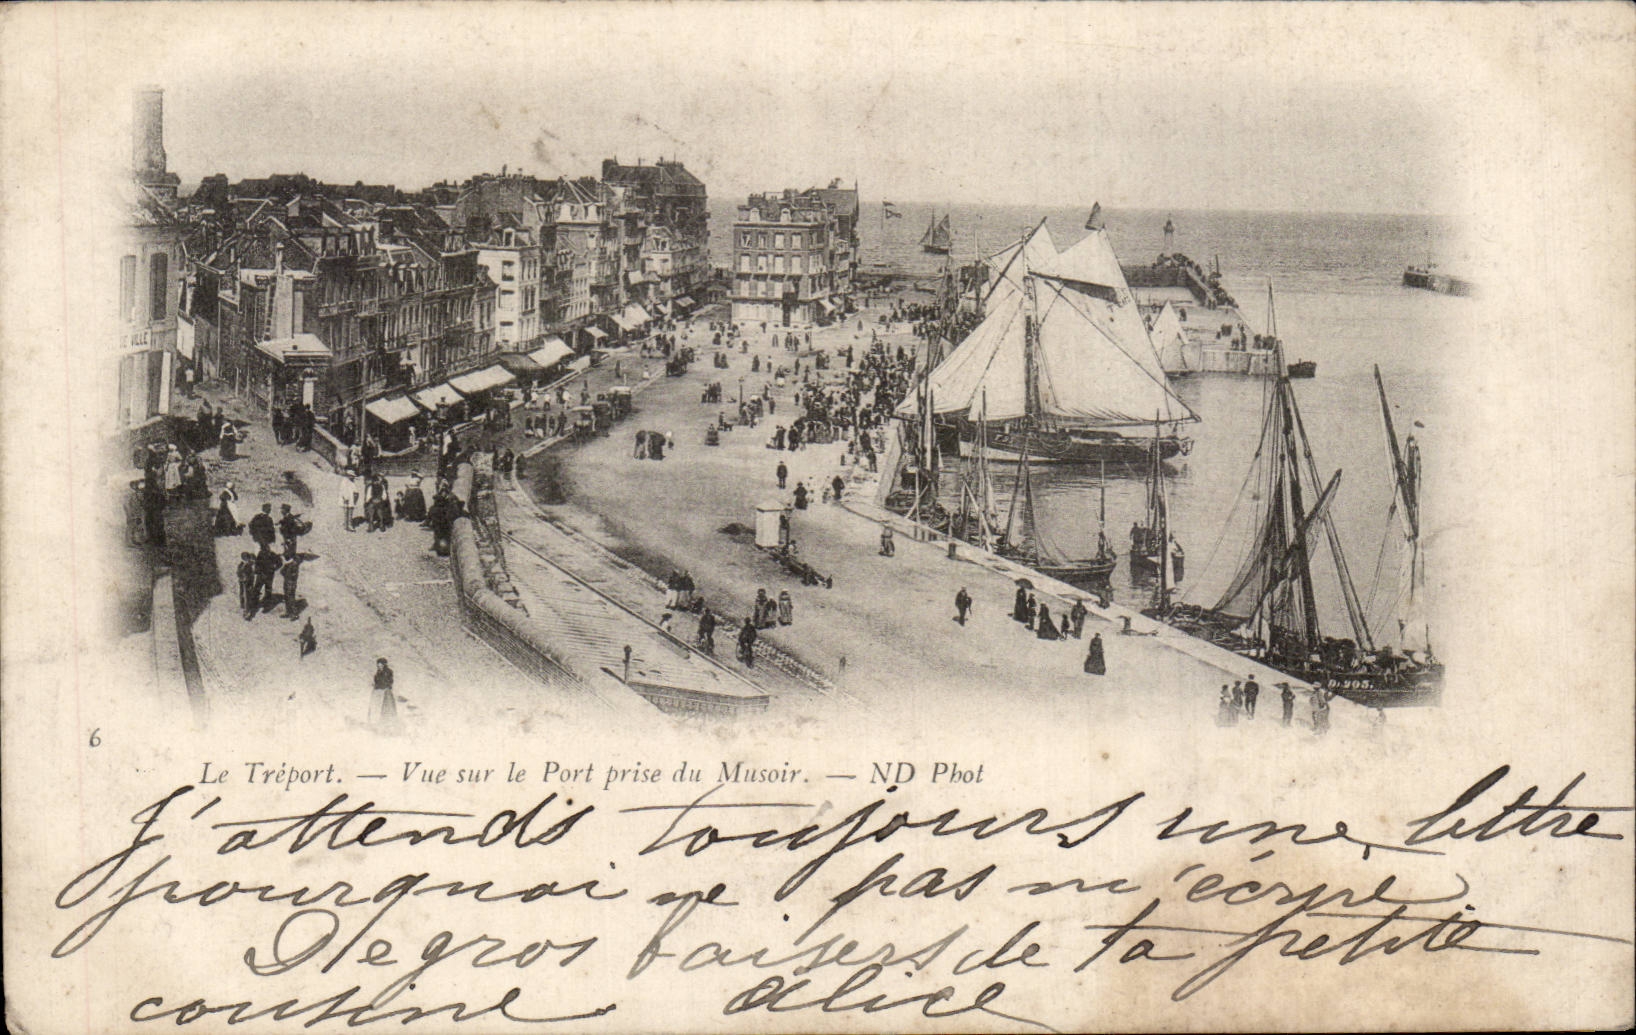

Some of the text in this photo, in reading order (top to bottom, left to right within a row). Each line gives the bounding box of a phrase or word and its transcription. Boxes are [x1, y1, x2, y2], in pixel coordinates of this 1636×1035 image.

[89, 727, 102, 748] 6
[200, 761, 228, 785] Le
[245, 761, 342, 792] Tréport.
[401, 761, 446, 785] Vue
[456, 767, 495, 785] sur
[507, 761, 527, 785] le
[543, 761, 594, 785] Port
[606, 761, 662, 792] prise
[672, 761, 702, 785] du
[717, 761, 810, 785] Musoir.
[870, 761, 916, 785] ND
[931, 761, 985, 785] Phot
[619, 782, 1147, 902] toujours
[1405, 765, 1634, 848] lettre
[51, 854, 629, 975] pourquoi
[798, 852, 998, 945] pas
[372, 928, 600, 1010] gros
[628, 898, 969, 981] baisers
[955, 920, 1053, 976] de
[1074, 897, 1200, 973] ta
[1170, 902, 1634, 1003] petite
[129, 979, 618, 1029] cousine
